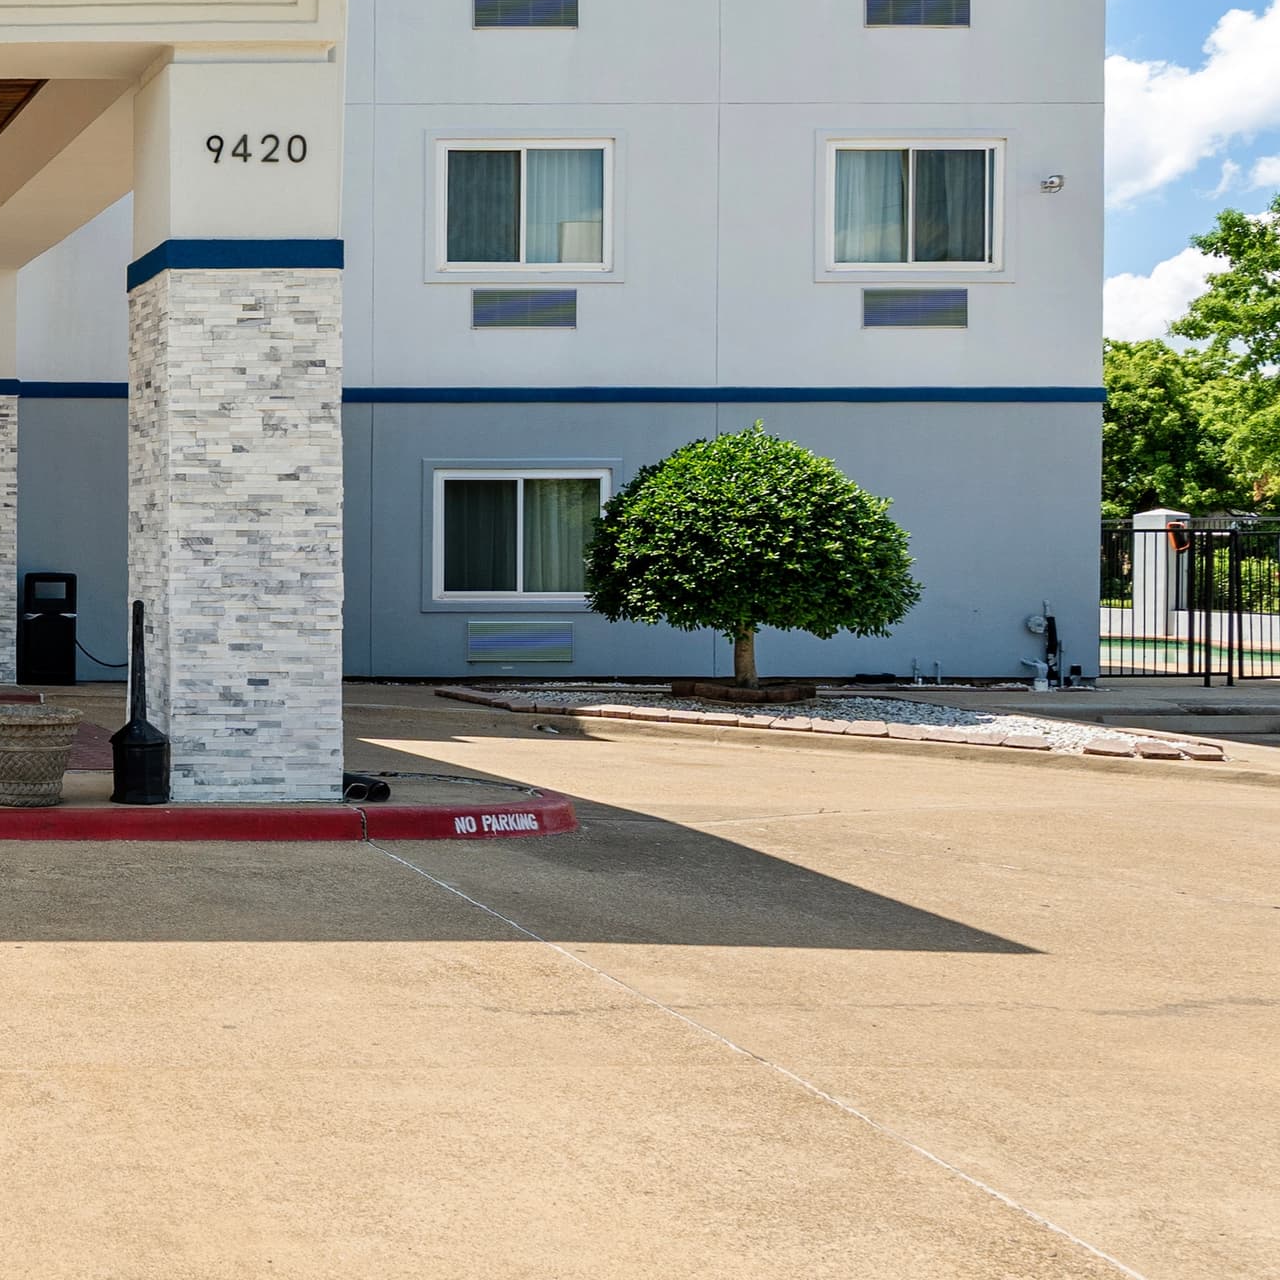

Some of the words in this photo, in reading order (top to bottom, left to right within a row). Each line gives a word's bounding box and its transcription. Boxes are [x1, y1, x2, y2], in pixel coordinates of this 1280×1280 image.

[206, 133, 307, 163] 9420
[454, 816, 477, 834] NO
[481, 813, 539, 832] PARKING
